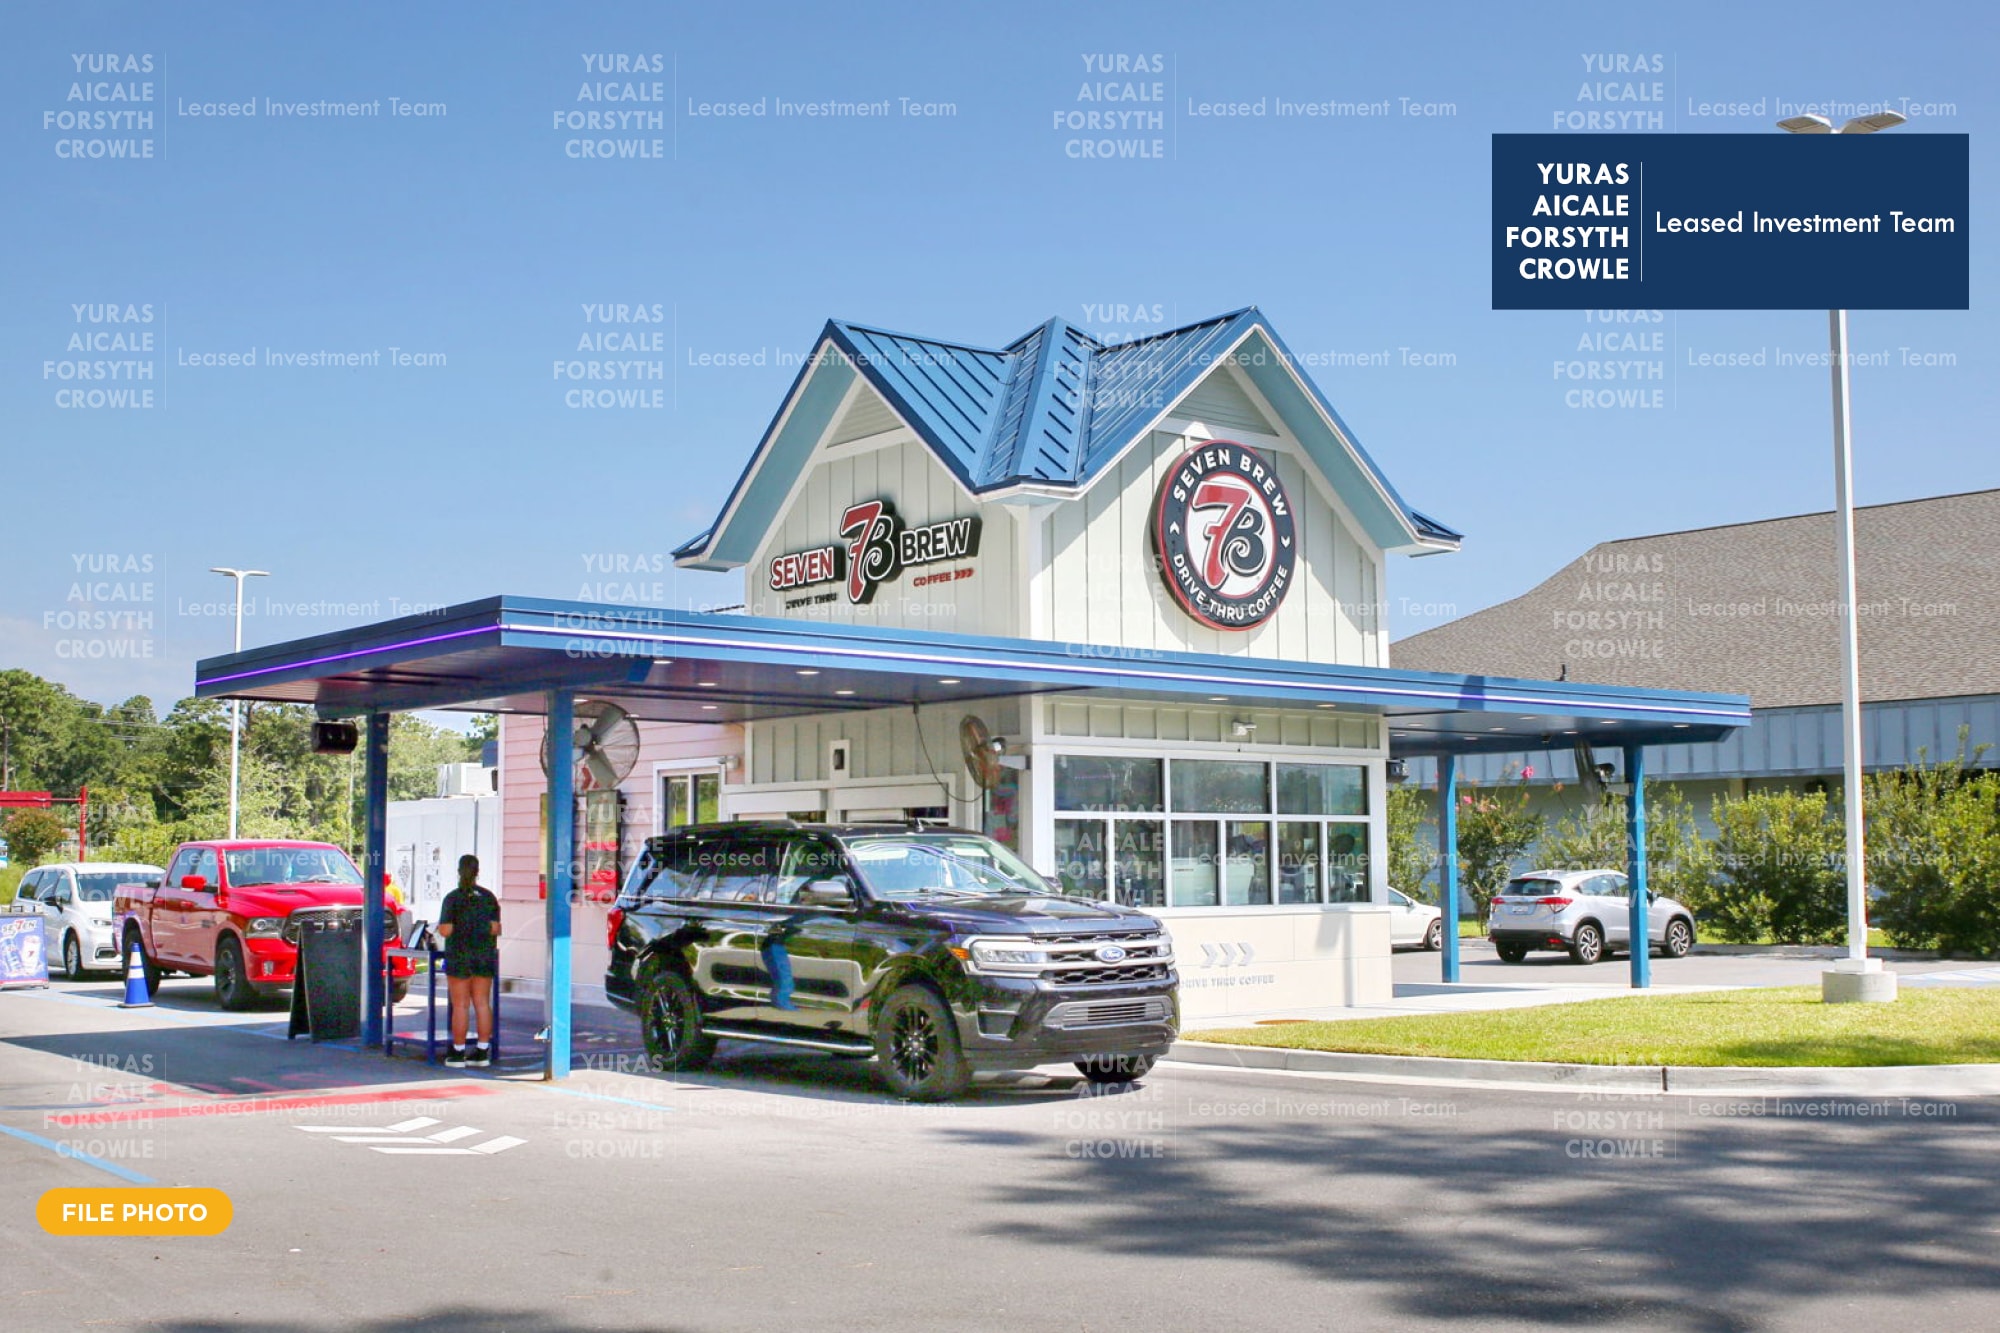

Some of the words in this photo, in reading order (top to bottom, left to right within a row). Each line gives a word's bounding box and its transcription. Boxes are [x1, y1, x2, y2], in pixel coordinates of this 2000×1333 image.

[1173, 449, 1231, 502] SEVEN
[1239, 454, 1287, 516] BREW
[771, 547, 834, 590] SEVEN
[901, 518, 971, 565] BREW
[913, 571, 952, 587] COFFEE
[1173, 554, 1206, 605] DRIVE
[1209, 600, 1245, 620] THRU
[1248, 564, 1288, 617] COFFEE
[785, 596, 813, 610] DRIVE
[814, 592, 838, 604] THRU
